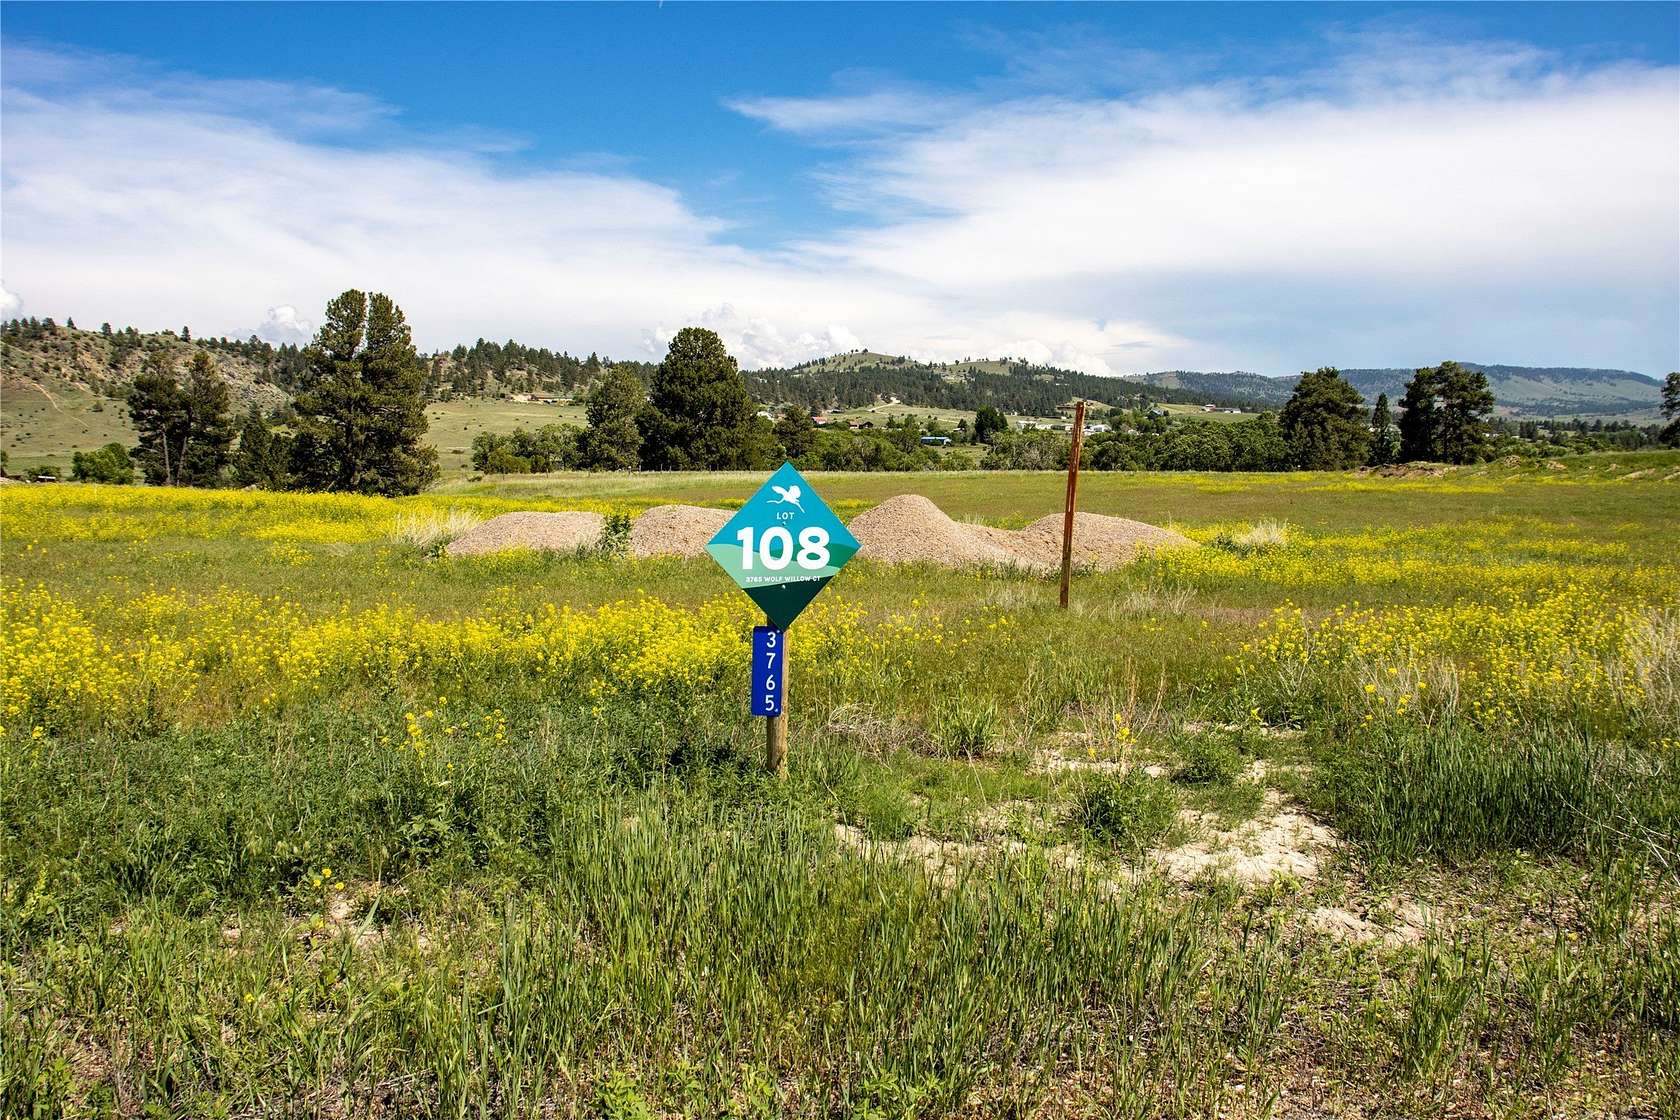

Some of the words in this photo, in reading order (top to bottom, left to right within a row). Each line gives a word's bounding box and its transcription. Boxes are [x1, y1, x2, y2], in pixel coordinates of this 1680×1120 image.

[776, 511, 795, 520] LOT
[736, 526, 831, 570] 108
[765, 631, 776, 711] 3765
